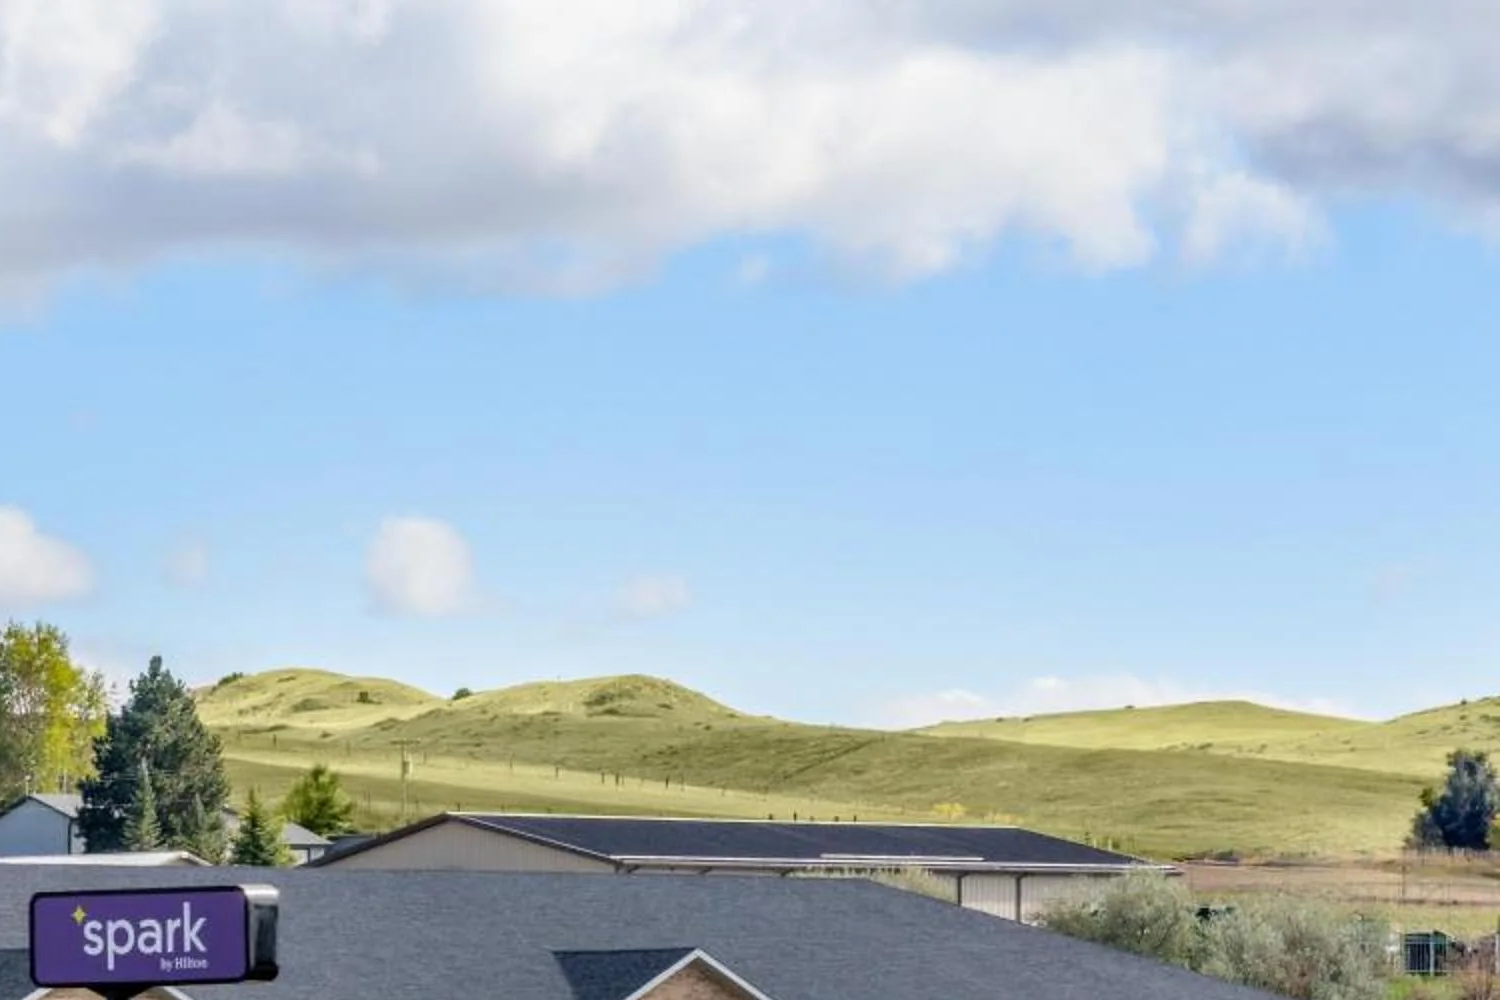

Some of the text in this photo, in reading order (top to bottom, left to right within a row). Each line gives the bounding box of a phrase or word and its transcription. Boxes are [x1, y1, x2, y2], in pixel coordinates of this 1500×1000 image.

[84, 901, 207, 970] spark
[160, 956, 207, 972] by Hilton
